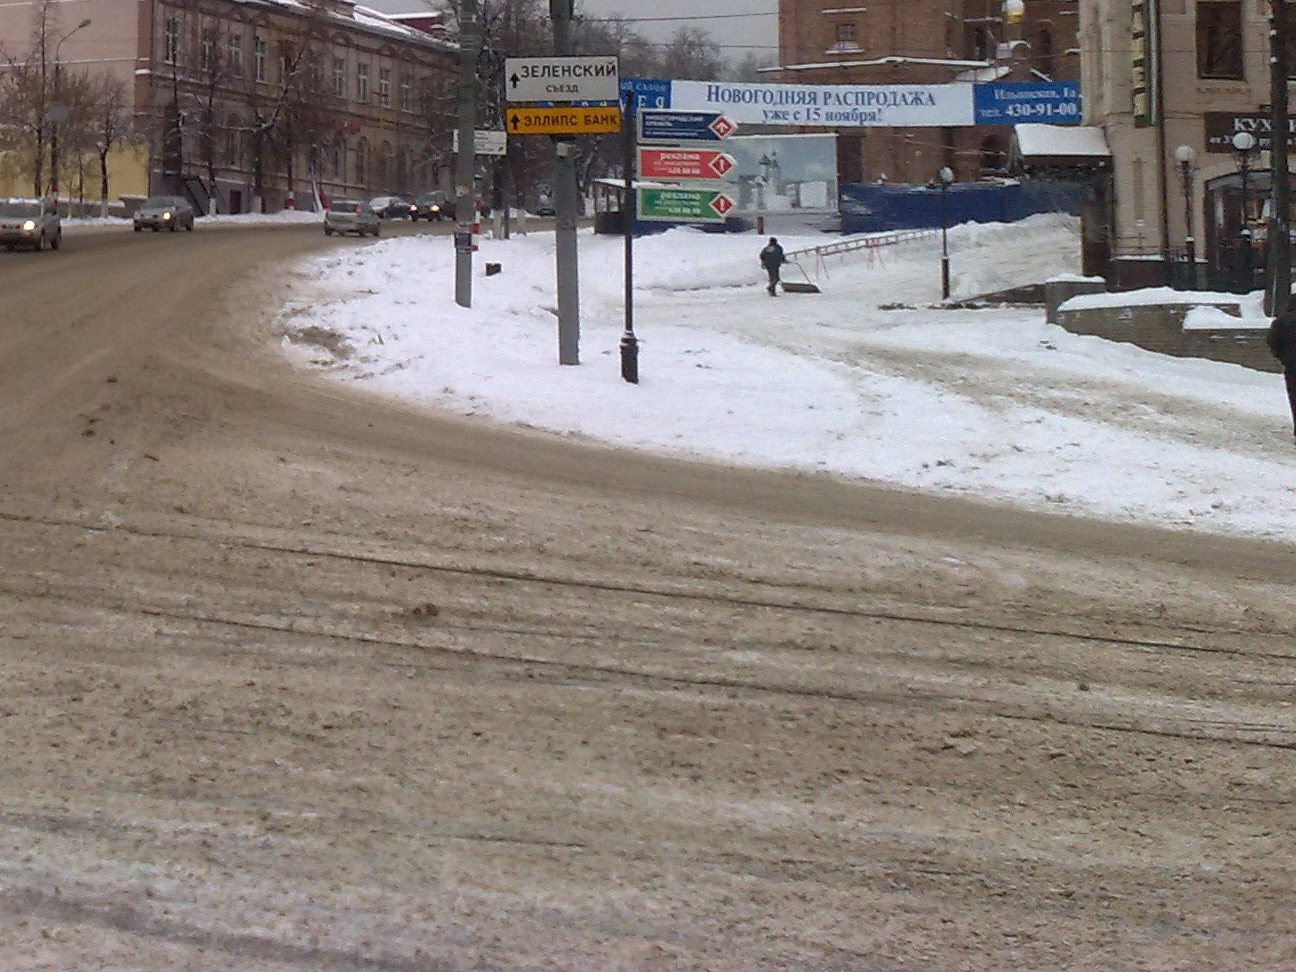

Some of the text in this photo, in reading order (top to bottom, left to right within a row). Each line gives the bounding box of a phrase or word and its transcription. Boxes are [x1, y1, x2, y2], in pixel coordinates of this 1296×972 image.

[520, 60, 617, 78] ЗЕЛЕНСКИЙ
[706, 84, 937, 107] НОВОГОДНЯЯ РАСПРОДАЖА
[761, 107, 883, 126] уже с 15 ноября!
[1005, 102, 1078, 117] 430-91-00
[523, 114, 618, 127] ЭЛЛИПС БАНК
